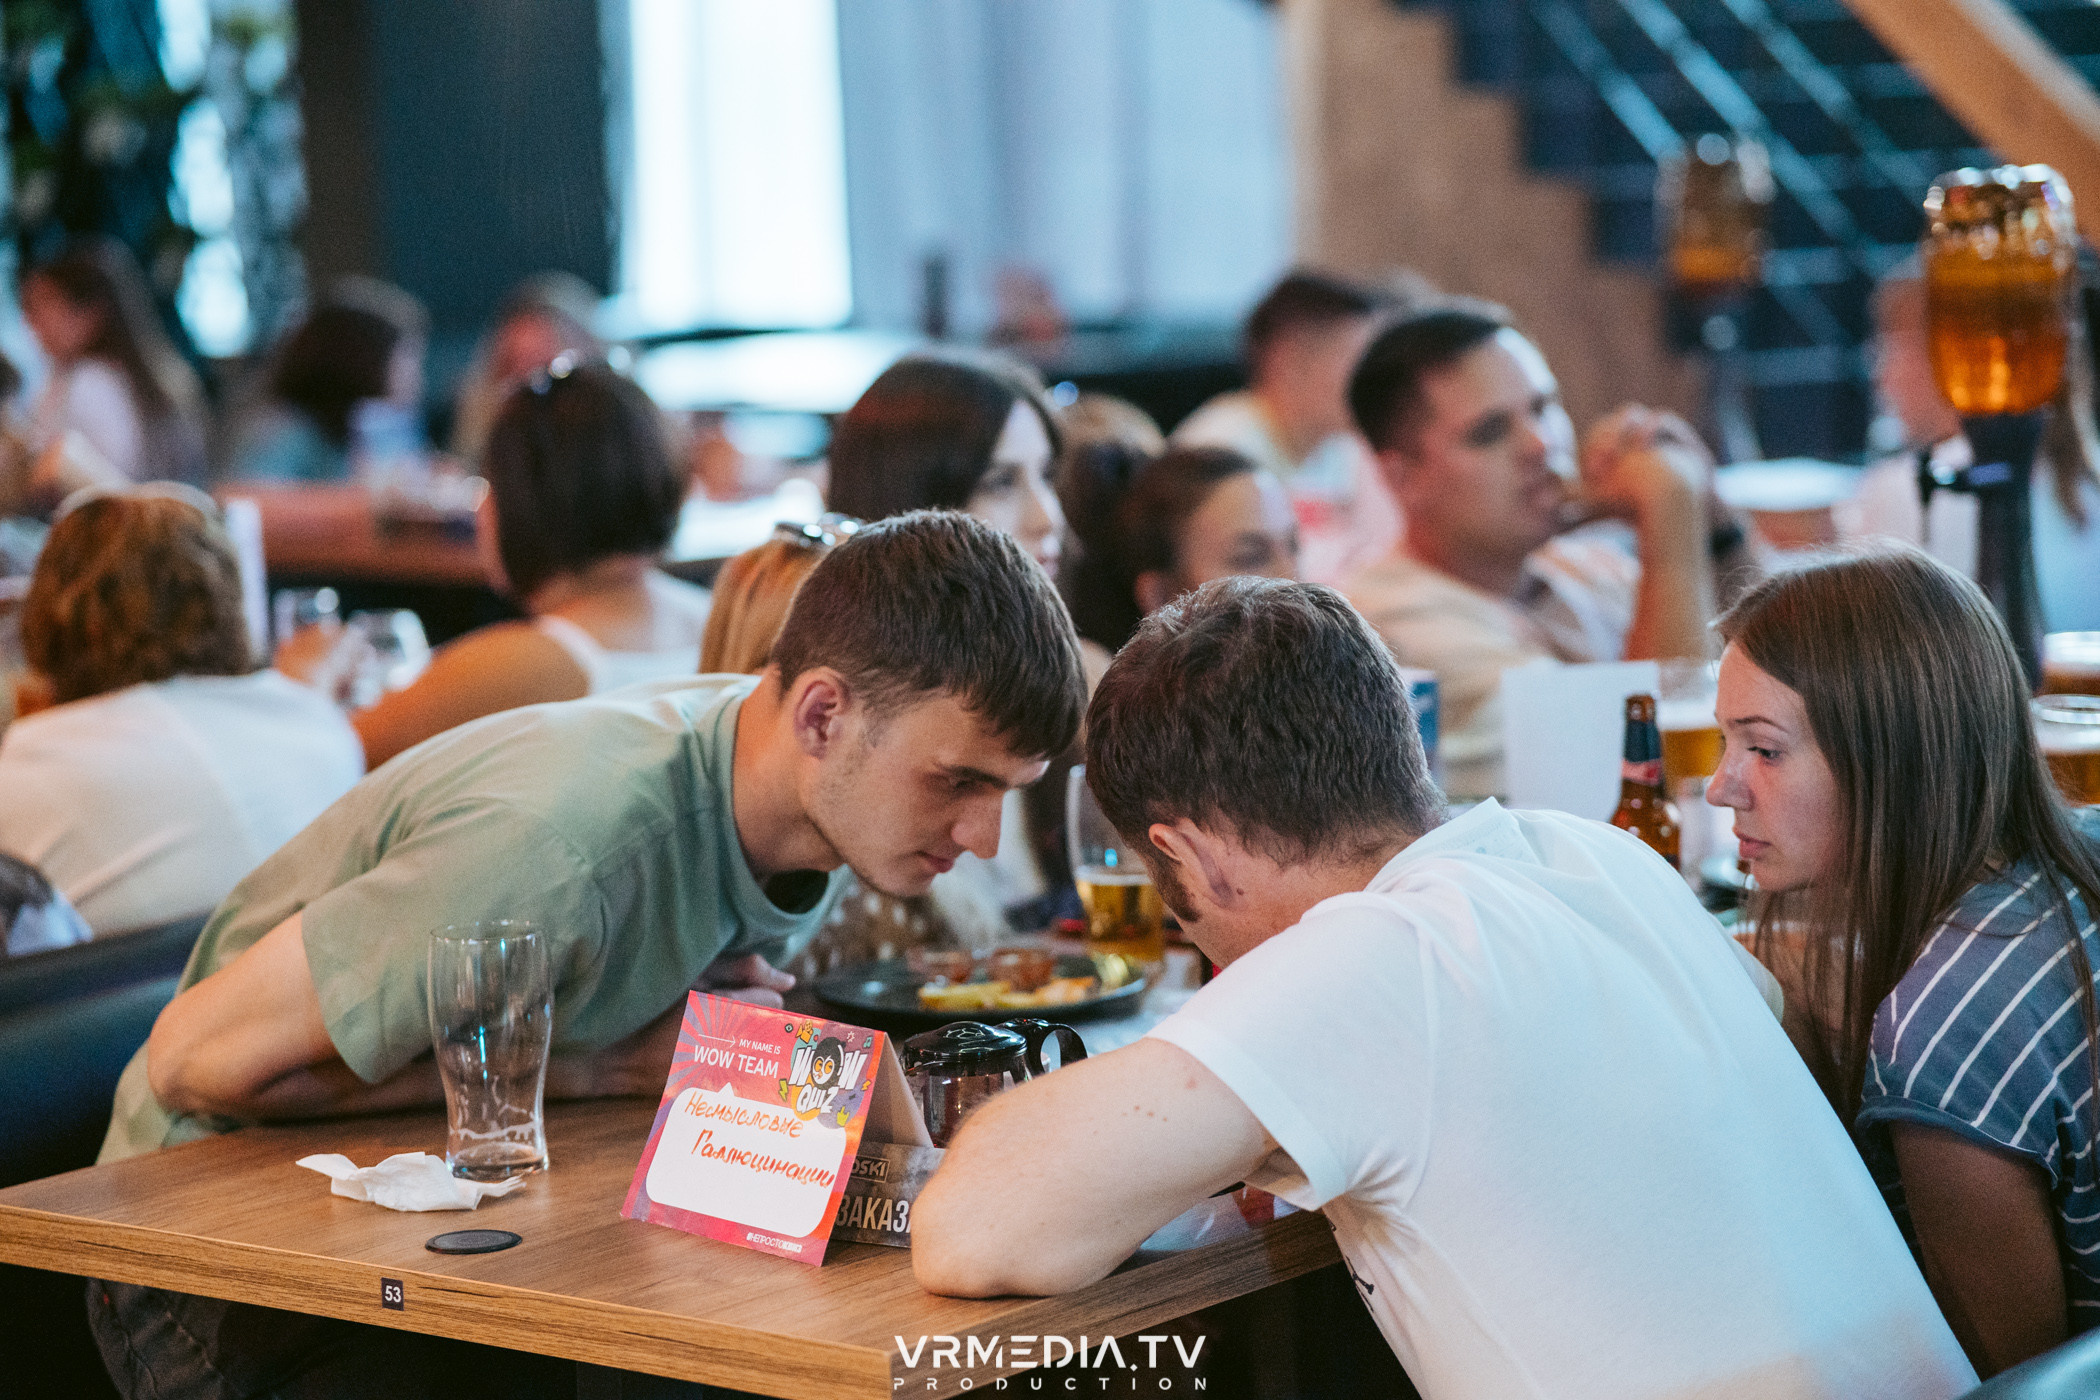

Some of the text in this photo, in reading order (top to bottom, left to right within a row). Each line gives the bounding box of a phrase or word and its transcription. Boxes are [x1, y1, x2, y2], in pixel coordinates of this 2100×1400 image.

[694, 1045, 779, 1078] WOW TEAM
[739, 1038, 781, 1054] MY NAME IS
[685, 1091, 803, 1138] Несмысловые
[796, 1084, 840, 1114] QUIZ
[836, 1194, 911, 1233] ЗАКАЗ
[385, 1285, 401, 1303] 53
